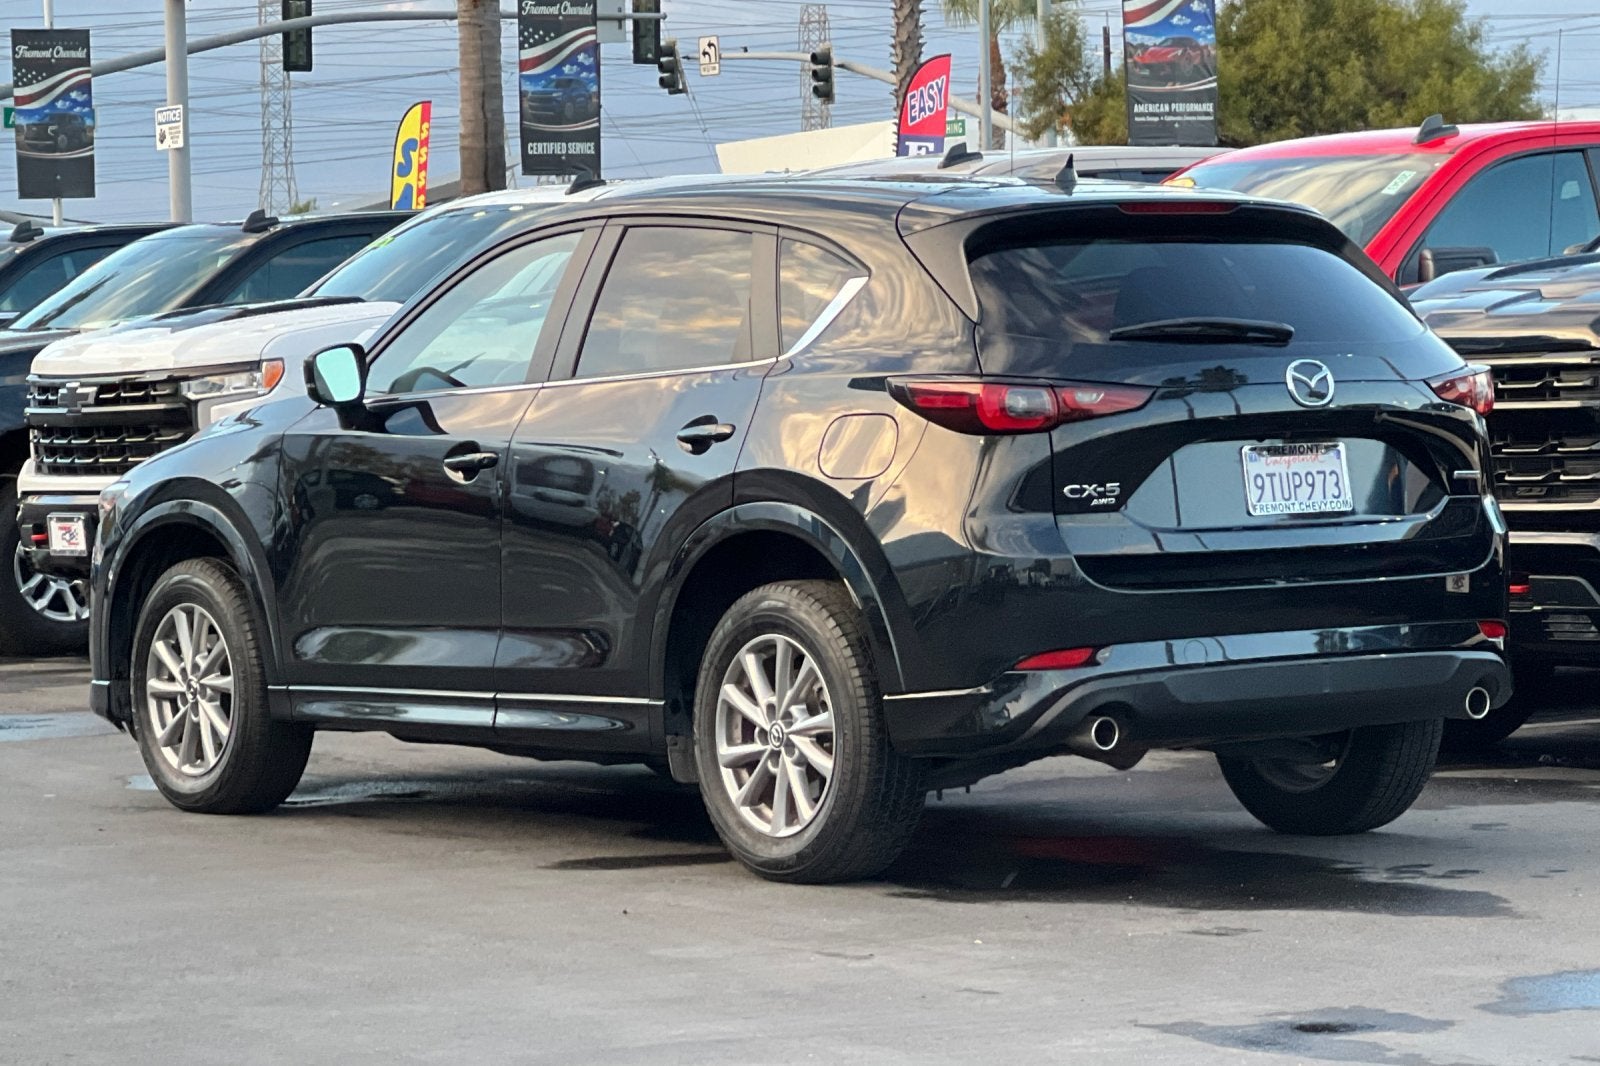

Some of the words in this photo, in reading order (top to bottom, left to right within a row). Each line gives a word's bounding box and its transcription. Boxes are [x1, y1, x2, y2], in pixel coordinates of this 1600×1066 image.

[908, 75, 947, 126] EASY
[1133, 103, 1169, 113] AMERICAN
[157, 110, 181, 123] NOTICE
[527, 142, 566, 155] CERTIFIED
[568, 142, 595, 154] SERVICE
[1063, 482, 1120, 498] CX-5
[1253, 470, 1342, 503] 9TUP973
[1090, 497, 1116, 506] AWD
